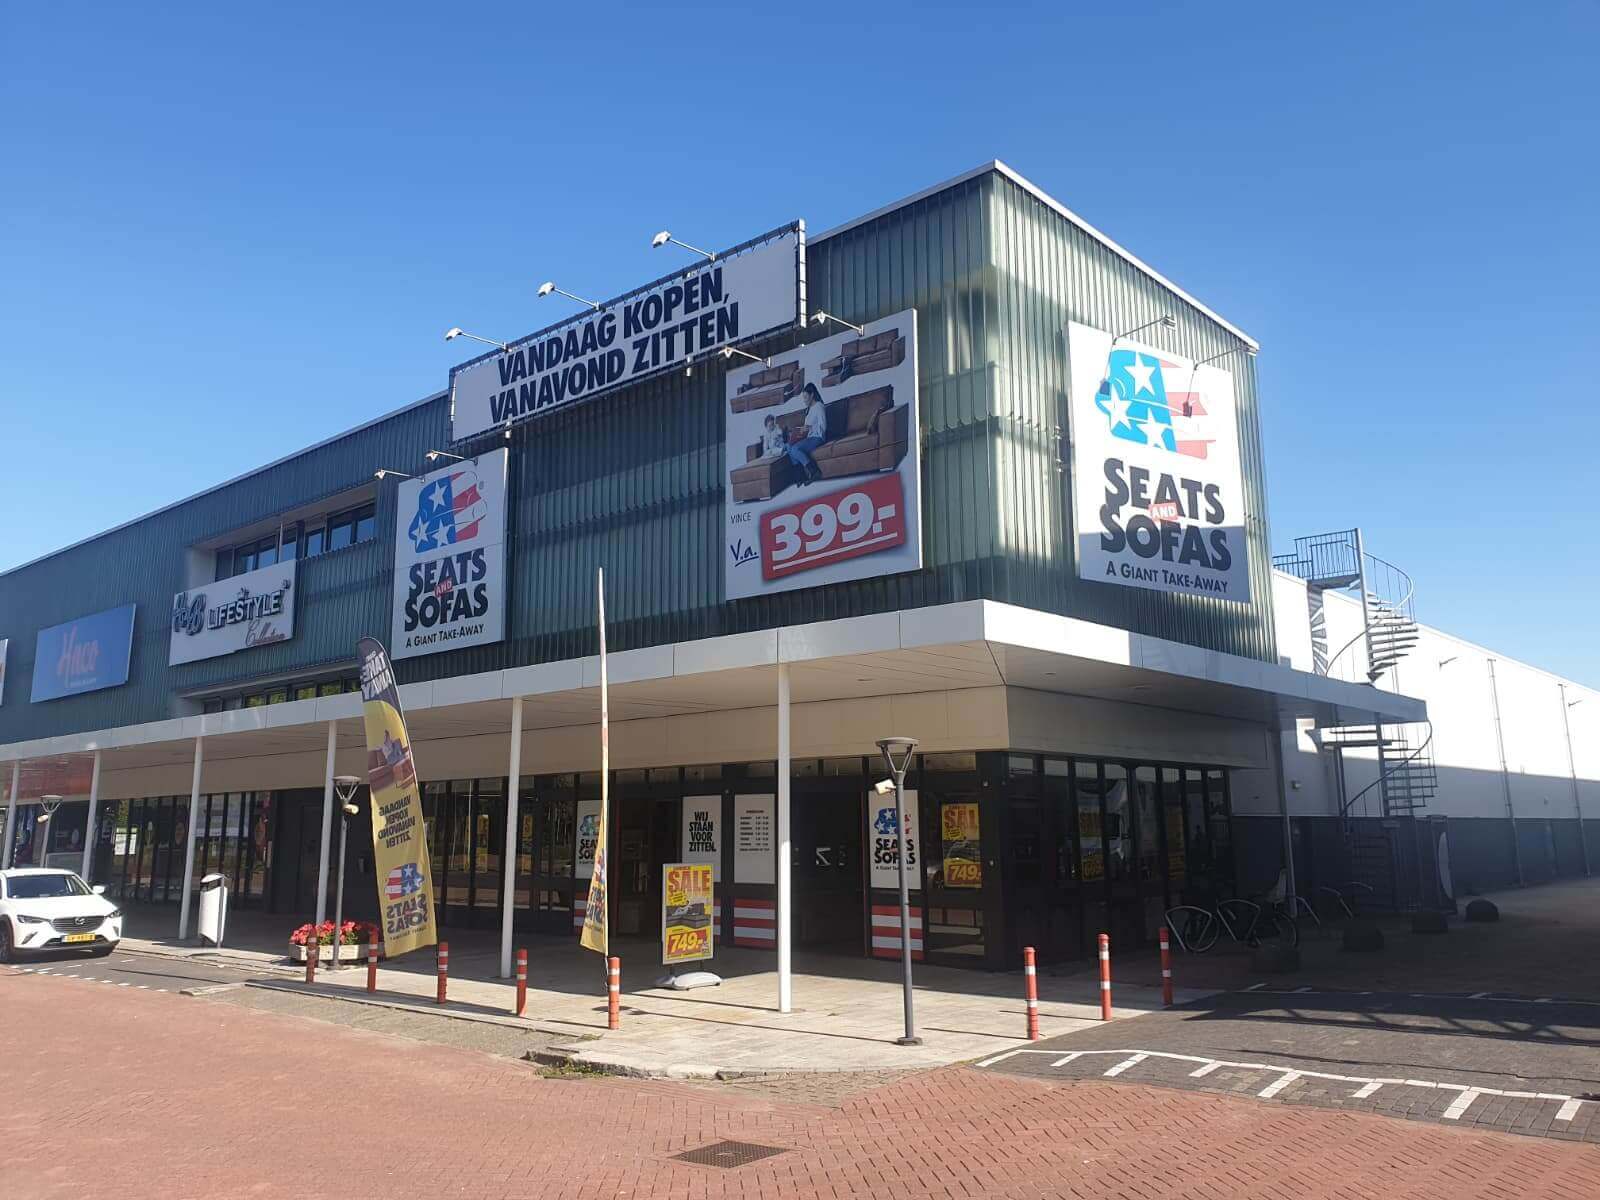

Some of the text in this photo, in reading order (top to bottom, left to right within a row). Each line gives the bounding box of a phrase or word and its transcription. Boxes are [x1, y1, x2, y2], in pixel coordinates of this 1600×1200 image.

[498, 267, 730, 387] VANDAAG KOPEN,
[489, 302, 739, 424] VANAVOND ZITTEN
[1103, 457, 1225, 525] SEATS
[730, 512, 752, 524] VINCE
[1151, 503, 1176, 521] AND
[1100, 503, 1232, 571] SOFAS
[408, 547, 487, 600] SEATS
[434, 578, 453, 597] AND
[1106, 560, 1229, 594] A GIANT TAKE-AWAY
[206, 590, 284, 631] LIFESTYLE
[404, 582, 489, 632] SOFAS
[405, 624, 485, 649] A GIANT TAKE-AWAY
[688, 821, 714, 832] STAAN
[694, 811, 709, 822] WIJ
[690, 832, 713, 842] VOOR
[668, 870, 710, 894] SALE
